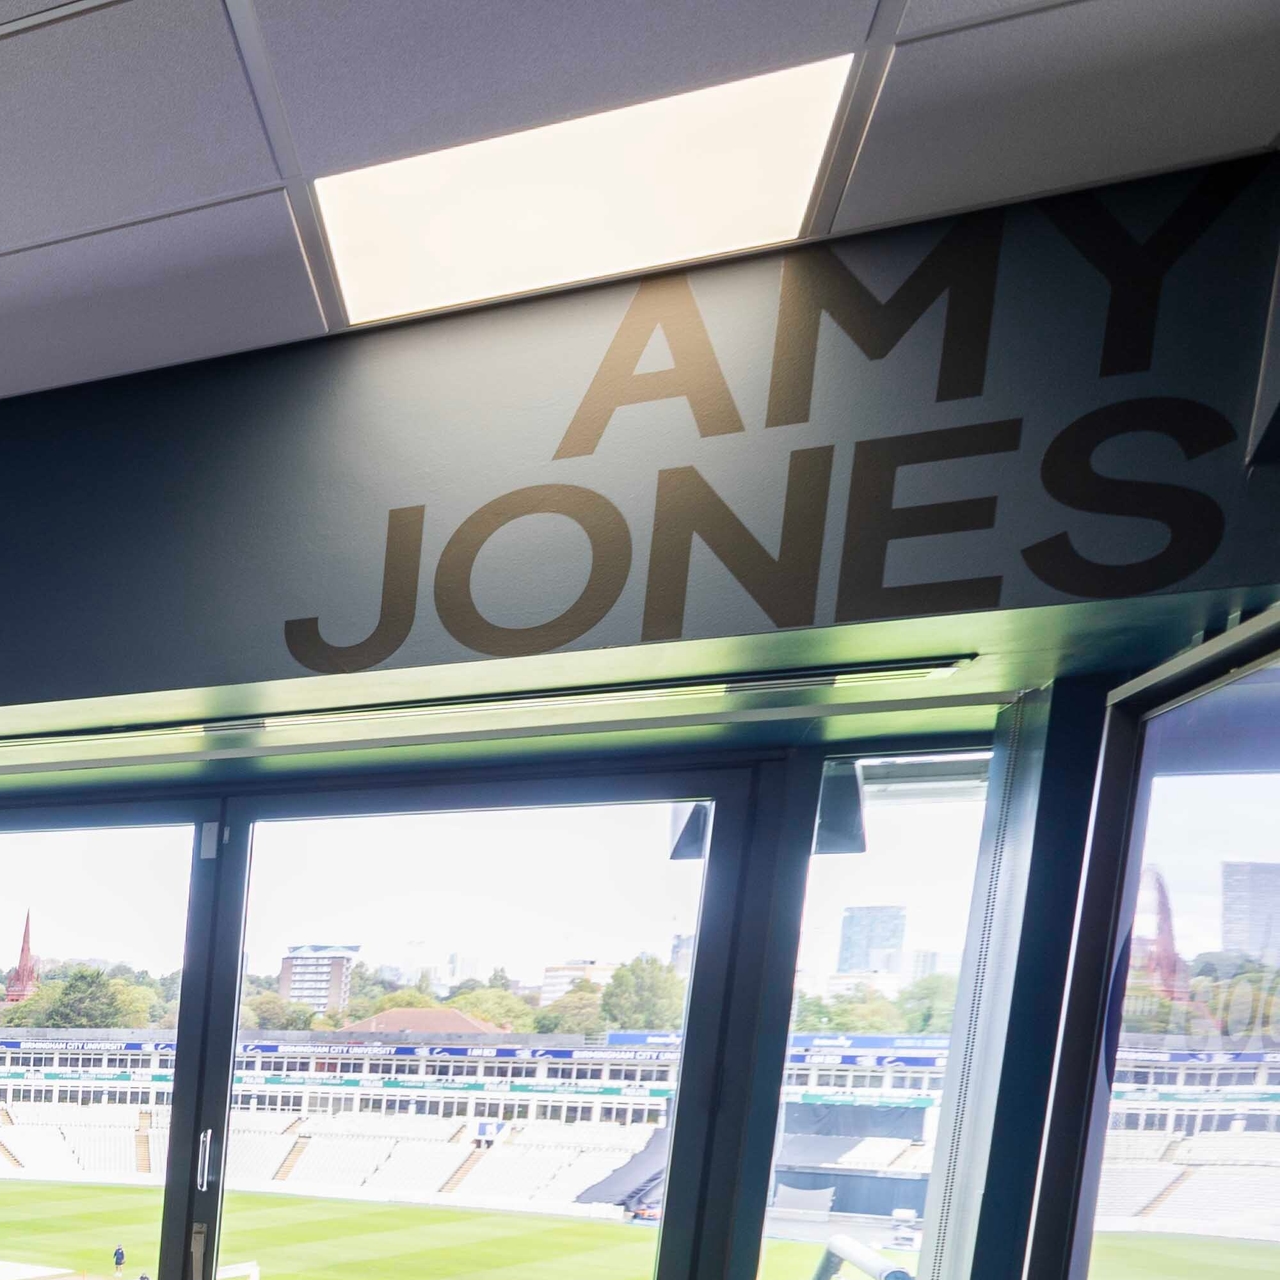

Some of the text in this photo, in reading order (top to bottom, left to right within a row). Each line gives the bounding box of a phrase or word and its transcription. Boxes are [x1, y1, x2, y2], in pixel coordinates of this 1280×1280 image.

[553, 152, 1268, 462] AMY
[284, 396, 1239, 675] JONES
[20, 1042, 127, 1051] BIRMINGHAM CITY UNIVERSITY
[277, 1045, 397, 1056] BIRMINGHAM CITY UNIVERSITY
[572, 1050, 635, 1059] BIRMINGHAM
[635, 1052, 658, 1060] CITY
